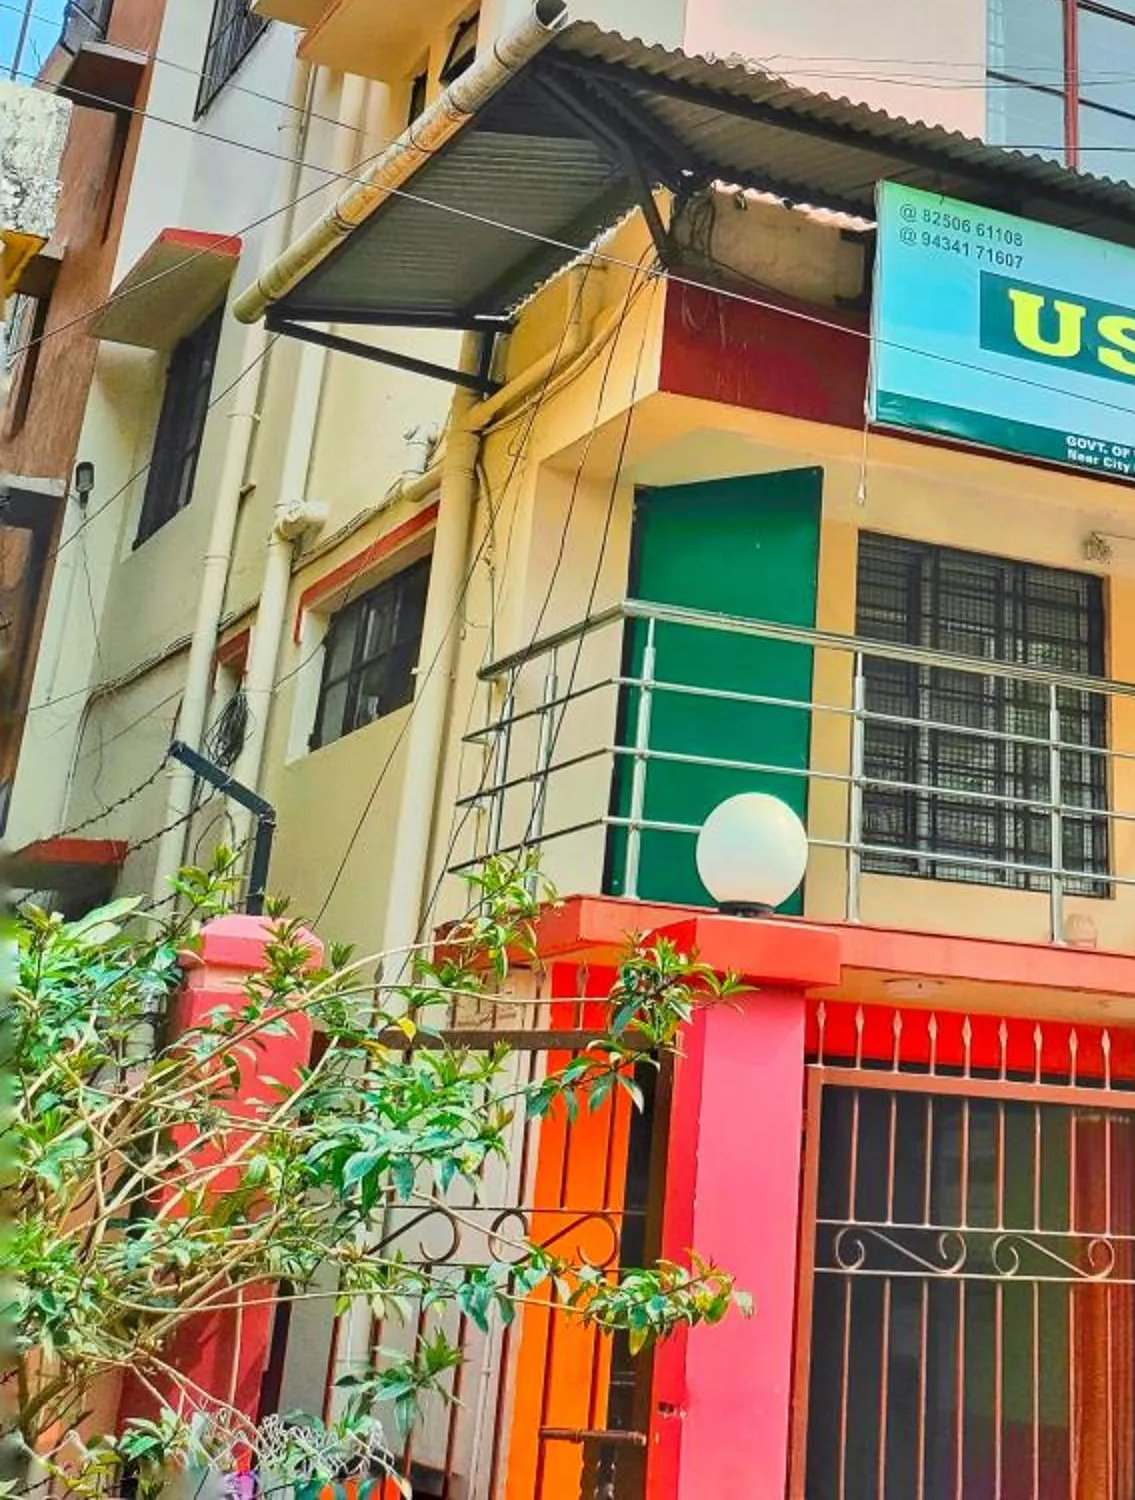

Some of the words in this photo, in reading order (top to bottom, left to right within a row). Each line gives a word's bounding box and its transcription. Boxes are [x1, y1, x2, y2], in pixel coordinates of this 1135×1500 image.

[921, 208, 971, 233] 82506
[975, 223, 1023, 247] 61108
[920, 230, 970, 257] 94341
[975, 244, 1023, 269] 71607
[1066, 435, 1108, 456] GOVT.
[1111, 445, 1131, 458] OF
[1067, 449, 1100, 465] Near
[1103, 456, 1130, 473] City
